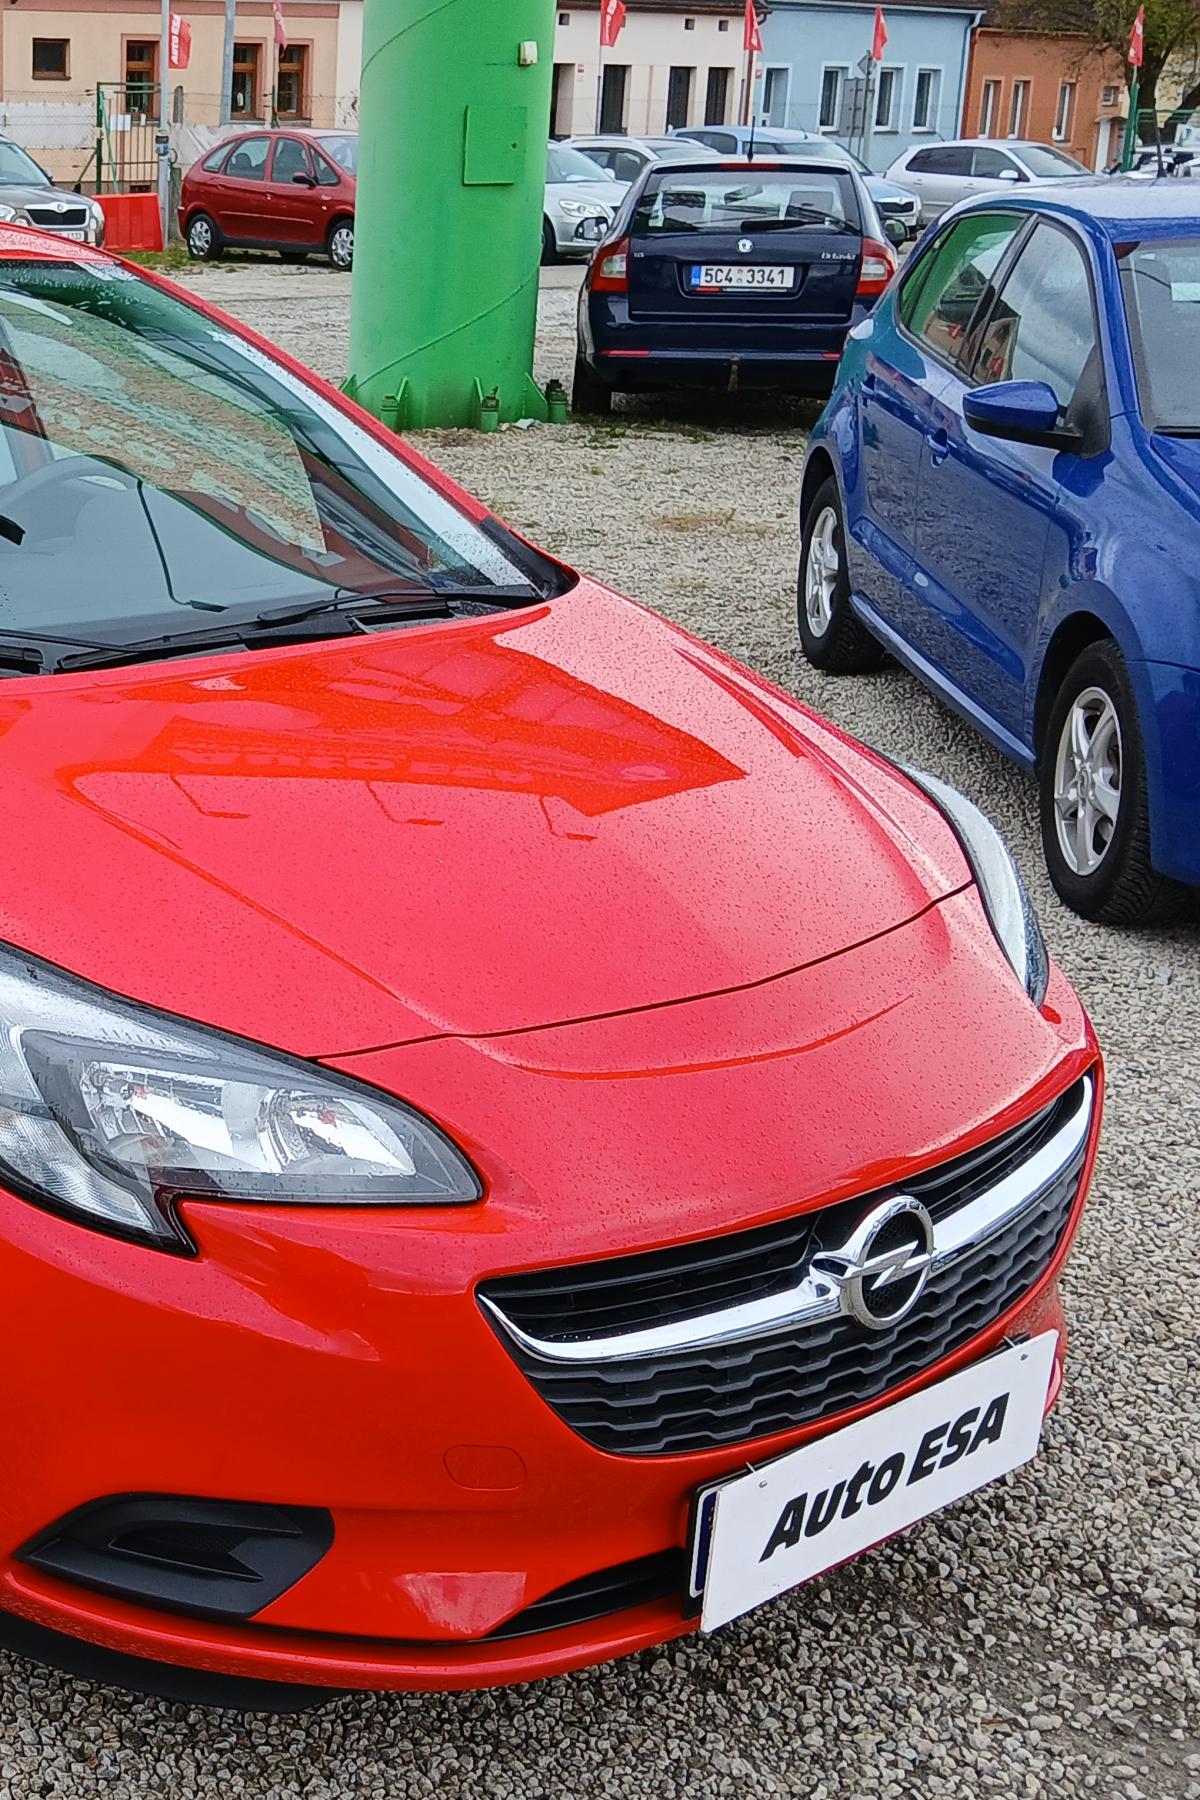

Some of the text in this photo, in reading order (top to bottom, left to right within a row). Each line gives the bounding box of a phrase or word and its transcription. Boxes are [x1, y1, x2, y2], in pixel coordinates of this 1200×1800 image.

[704, 268, 785, 285] 5C4 3341
[759, 1391, 1011, 1563] Auto ESA
